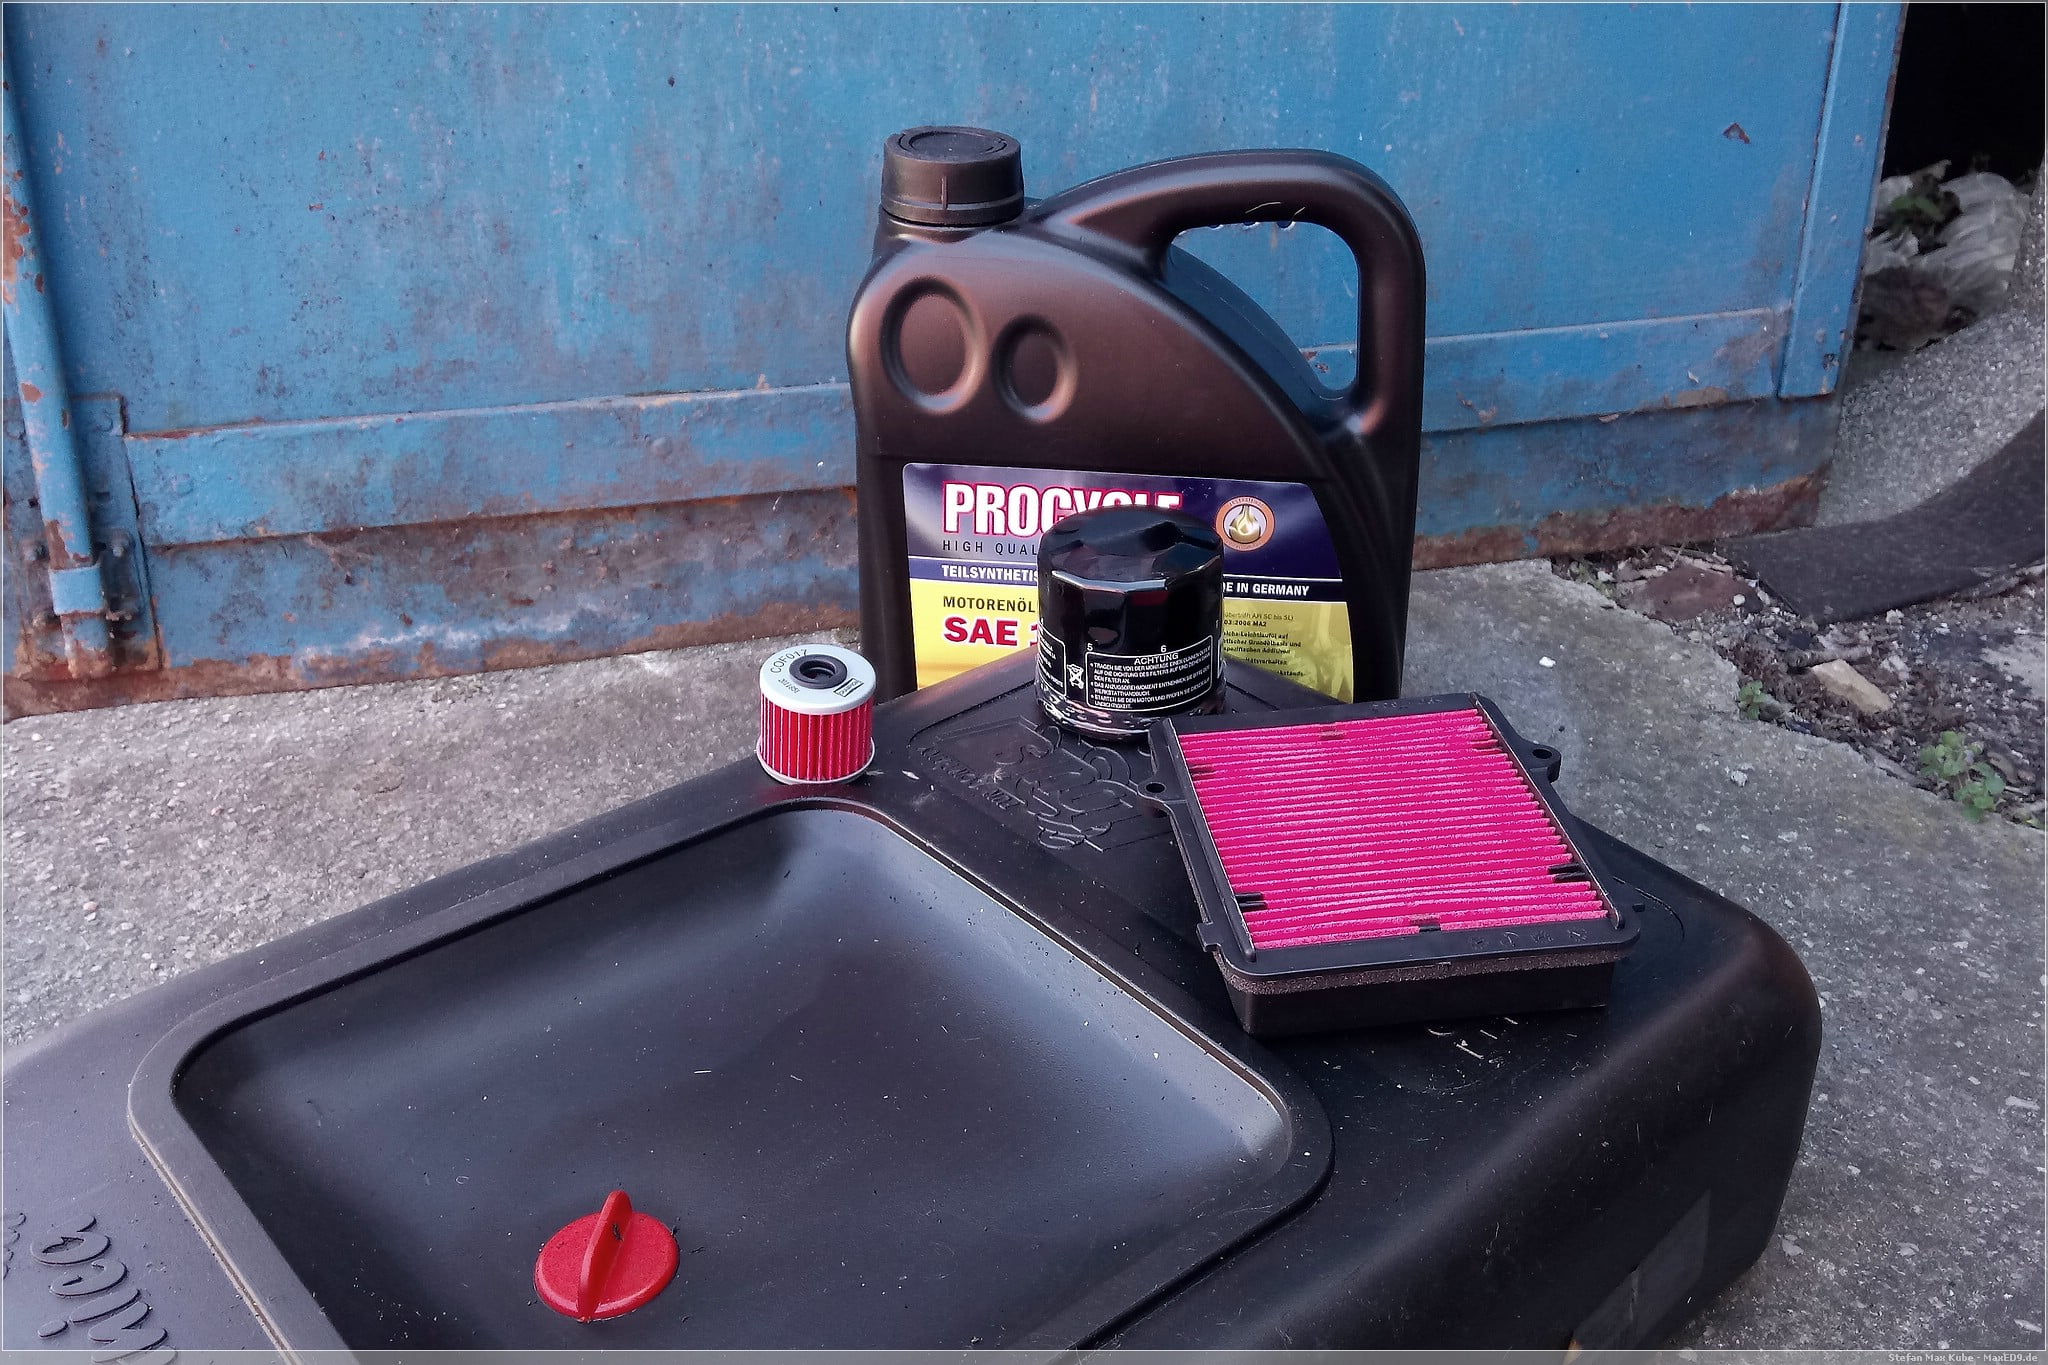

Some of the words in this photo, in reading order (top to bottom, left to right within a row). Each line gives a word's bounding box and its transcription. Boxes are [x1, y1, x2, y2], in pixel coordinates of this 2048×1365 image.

[943, 540, 983, 553] HIGH
[995, 542, 1037, 556] QUAL
[1236, 582, 1249, 593] IN
[1252, 583, 1310, 597] GERMANY
[943, 596, 1036, 613] MOTORENÖL
[944, 616, 1018, 647] SAE
[1087, 643, 1094, 651] 5
[1160, 644, 1167, 653] 6
[1134, 652, 1179, 666] ACHTUNG
